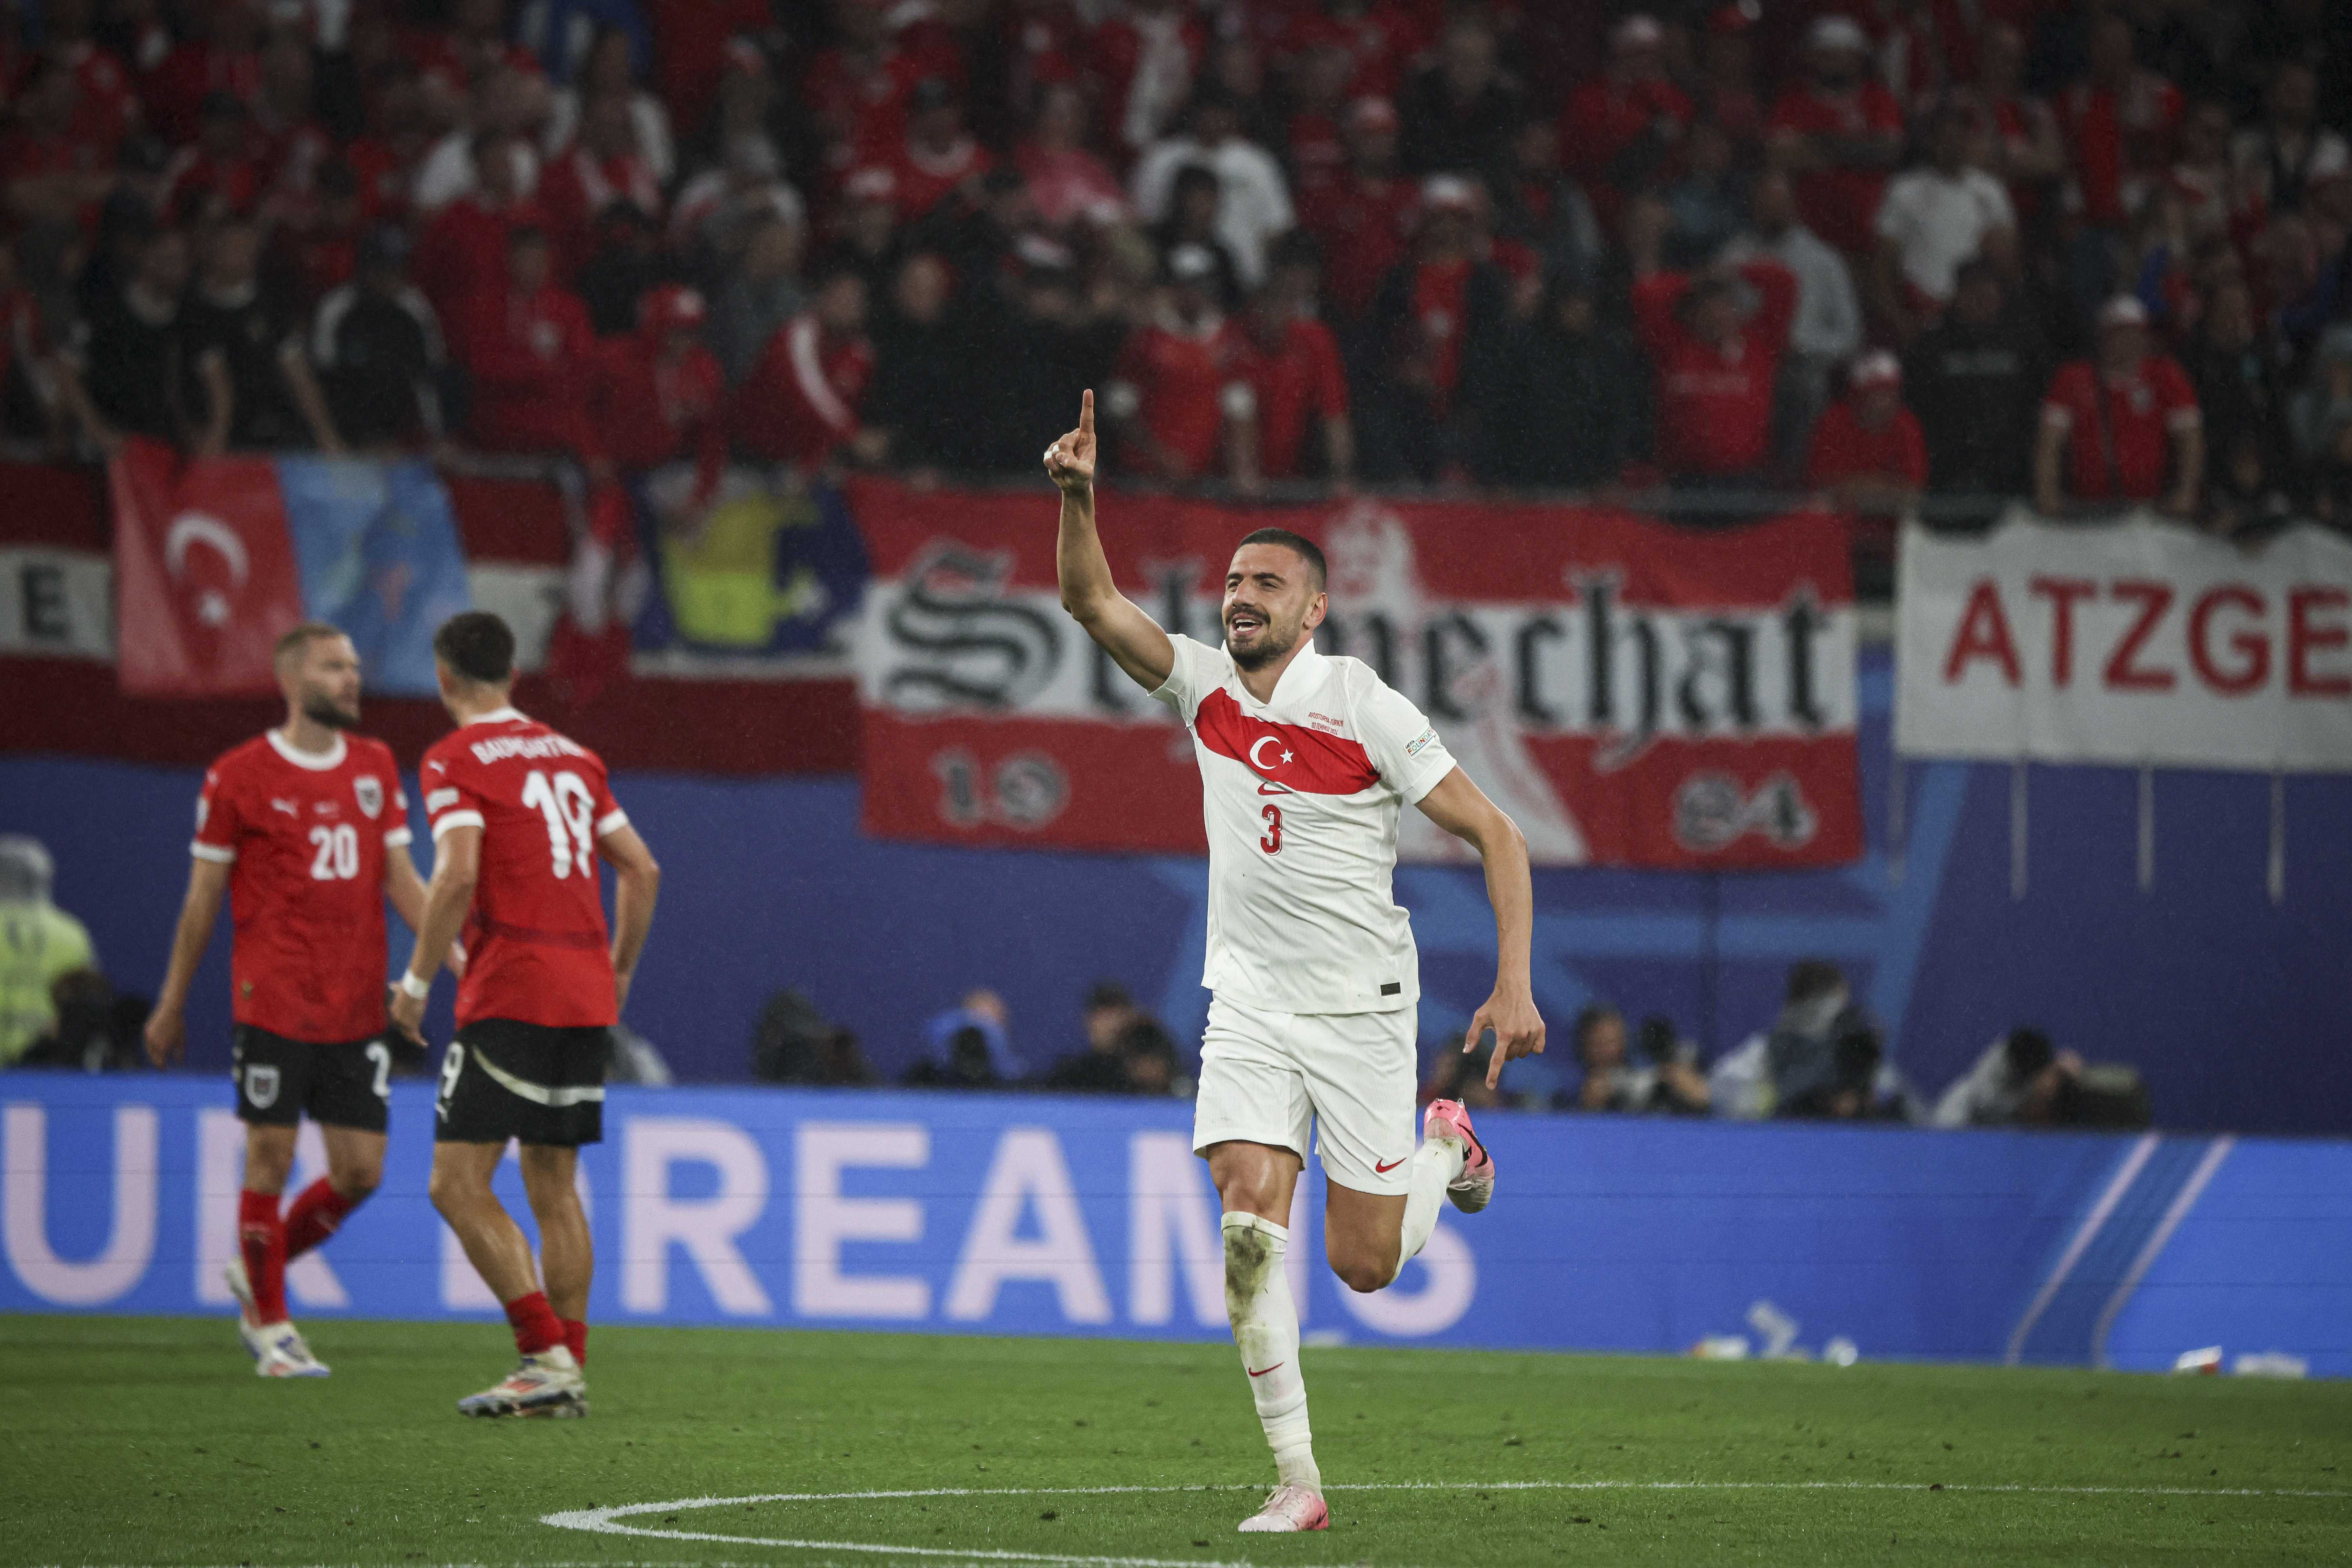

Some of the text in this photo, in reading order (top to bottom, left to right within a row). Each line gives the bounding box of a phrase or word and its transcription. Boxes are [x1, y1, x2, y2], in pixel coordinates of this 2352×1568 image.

[1405, 740, 1415, 749] UEFA
[309, 824, 359, 880] 20
[521, 769, 596, 879] 19
[1260, 804, 1283, 856] 3
[441, 1115, 1478, 1338] REAMS
